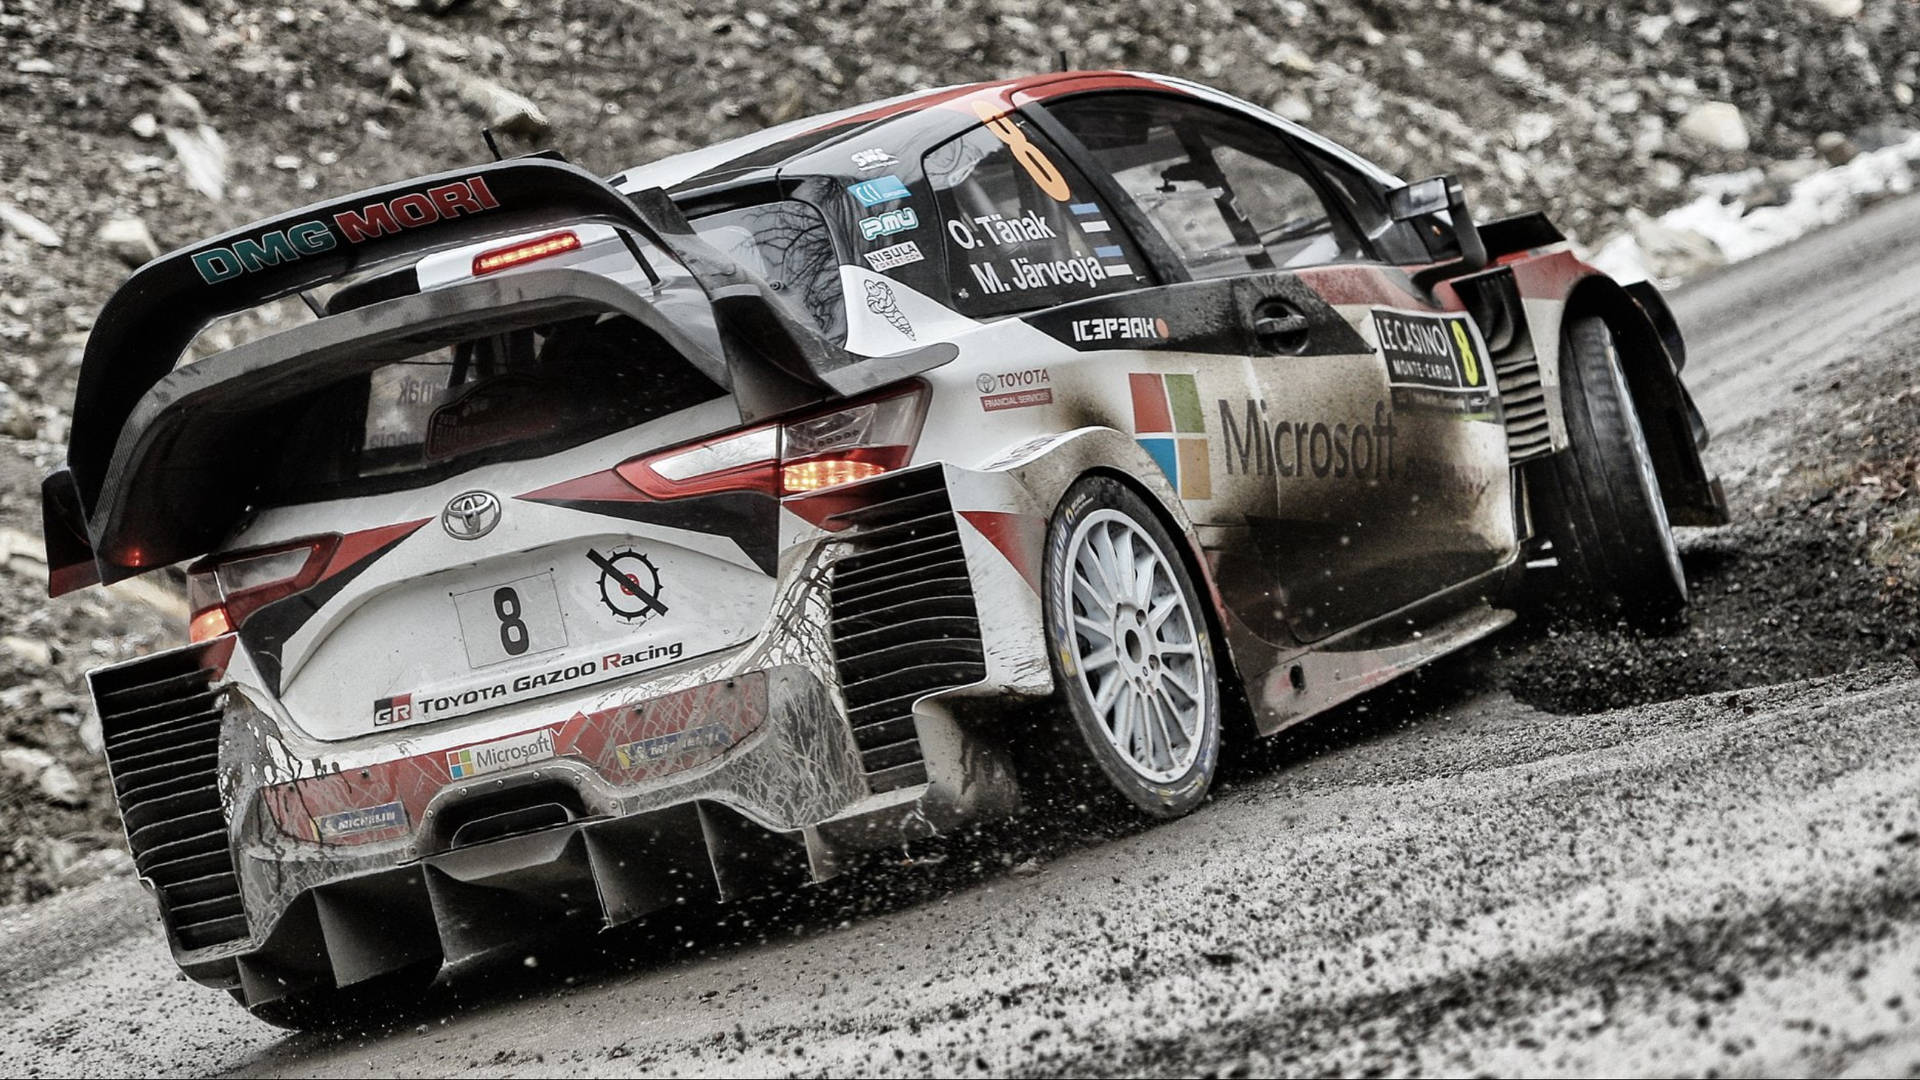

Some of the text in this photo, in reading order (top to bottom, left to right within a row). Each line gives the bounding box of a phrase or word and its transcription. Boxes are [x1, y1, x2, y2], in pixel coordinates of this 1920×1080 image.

[971, 101, 1071, 202] 8
[191, 176, 500, 286] DMG MORI
[947, 209, 1057, 250] O. Tänak
[867, 244, 918, 265] NISULA
[970, 250, 1107, 294] M. Järveoja
[1072, 317, 1156, 342] ICEPEAK
[1392, 359, 1454, 381] MONTE-CARLO
[1450, 319, 1480, 386] 8
[997, 368, 1050, 389] TOYOTA
[1217, 399, 1398, 479] Microsoft
[493, 586, 530, 657] 8
[418, 641, 684, 714] TOYOTA GAZOO Racing
[373, 701, 412, 727] GR
[476, 730, 551, 769] Microsoft
[337, 811, 397, 832] MICHELIN
